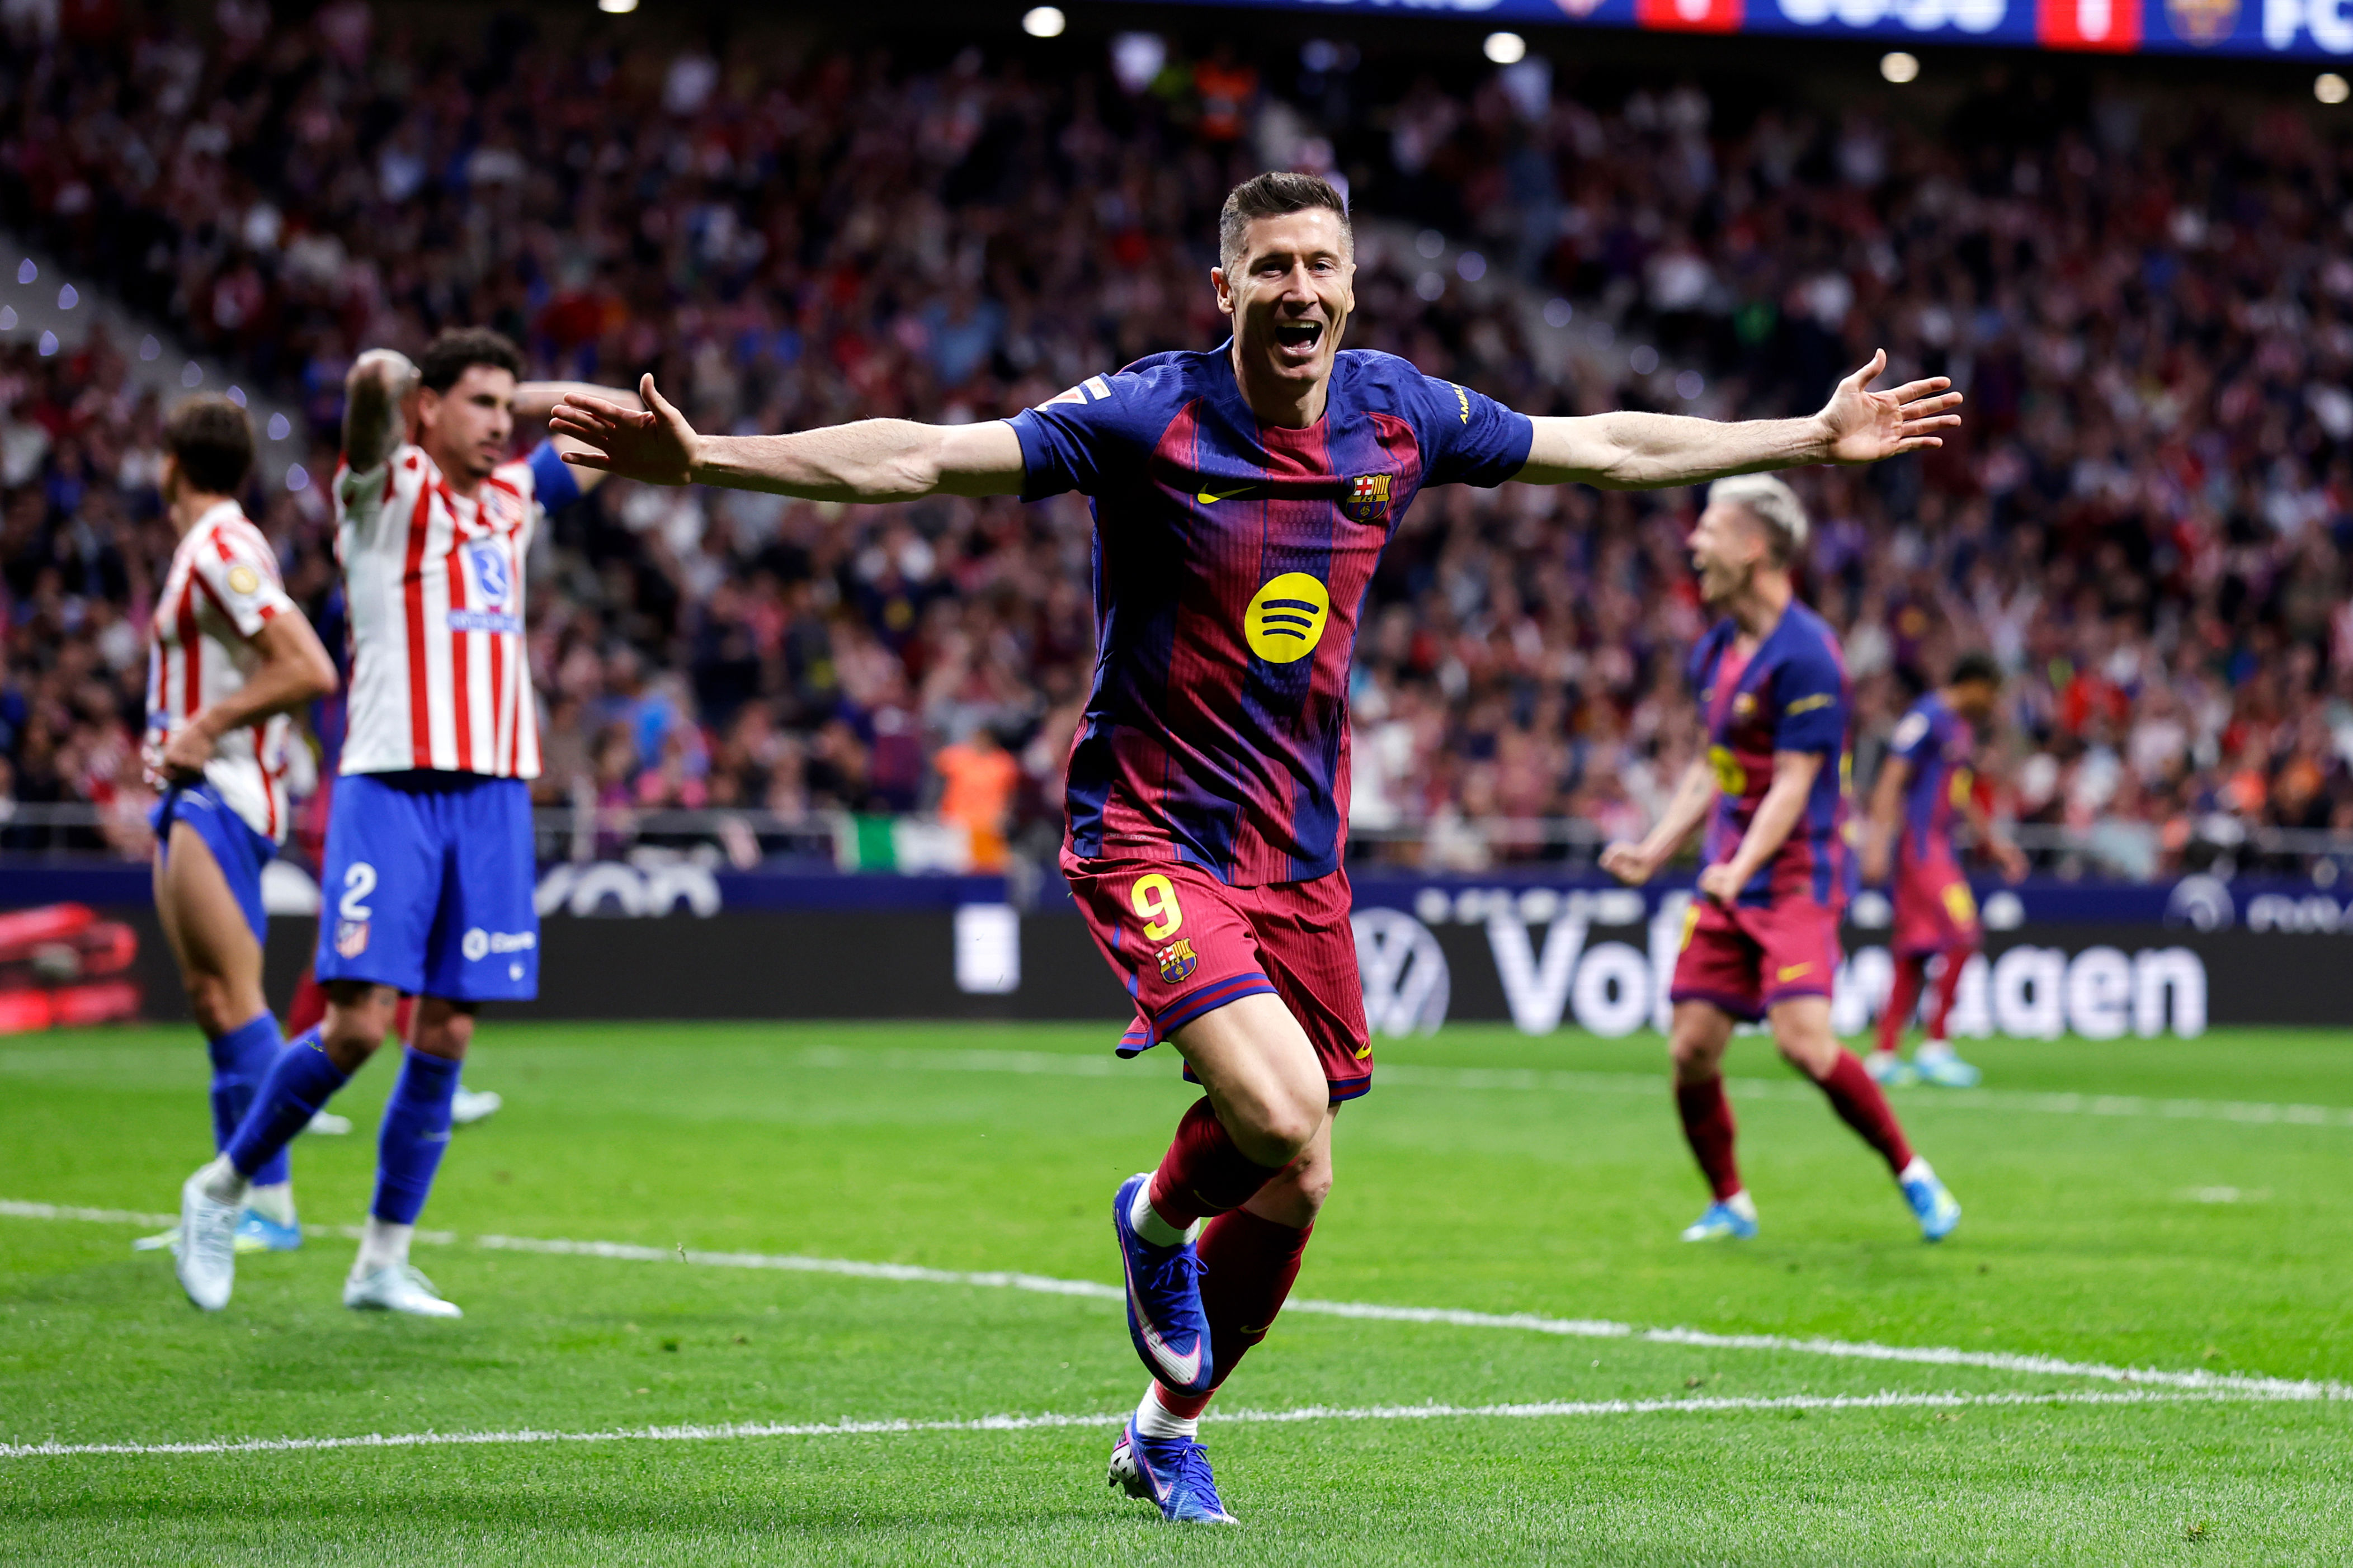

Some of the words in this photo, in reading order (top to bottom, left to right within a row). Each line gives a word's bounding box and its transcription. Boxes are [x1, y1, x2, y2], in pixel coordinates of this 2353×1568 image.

[1450, 382, 1469, 425] AMBILI
[339, 861, 378, 922] 2
[1131, 873, 1183, 941] 9
[1485, 890, 2209, 1041] Volagen
